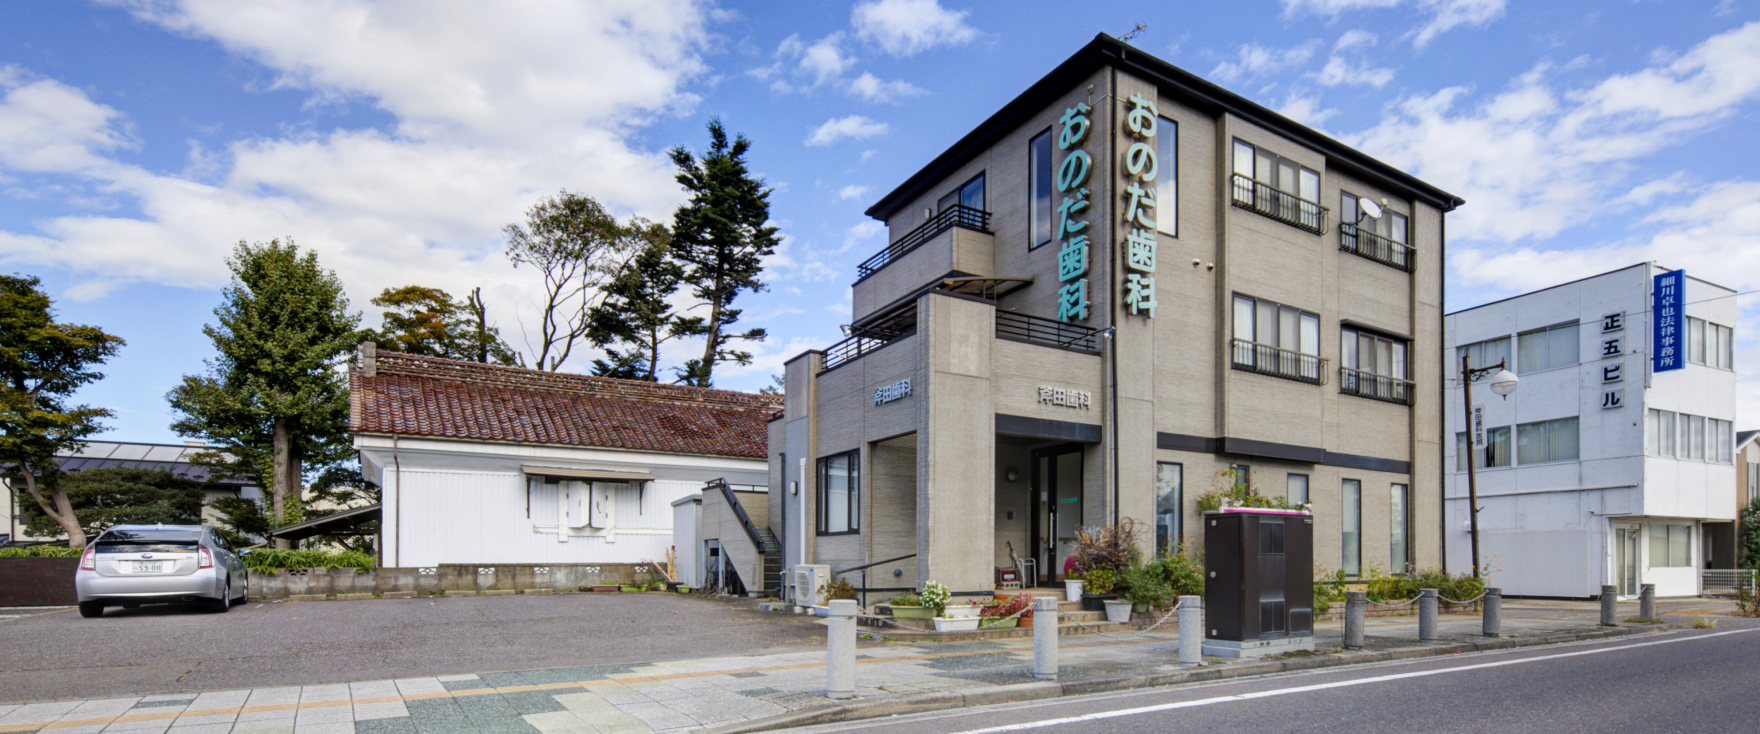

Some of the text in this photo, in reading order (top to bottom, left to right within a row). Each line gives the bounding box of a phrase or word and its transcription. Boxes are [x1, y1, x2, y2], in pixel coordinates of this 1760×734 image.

[1057, 102, 1090, 322] おのだ歯科
[1126, 92, 1159, 319] おのだ歯科
[1603, 313, 1622, 408] 正五ビル
[1660, 276, 1676, 368] 細川卓也法律事務所
[874, 377, 911, 406] 斧田歯科
[1038, 385, 1091, 409] 斧田歯科
